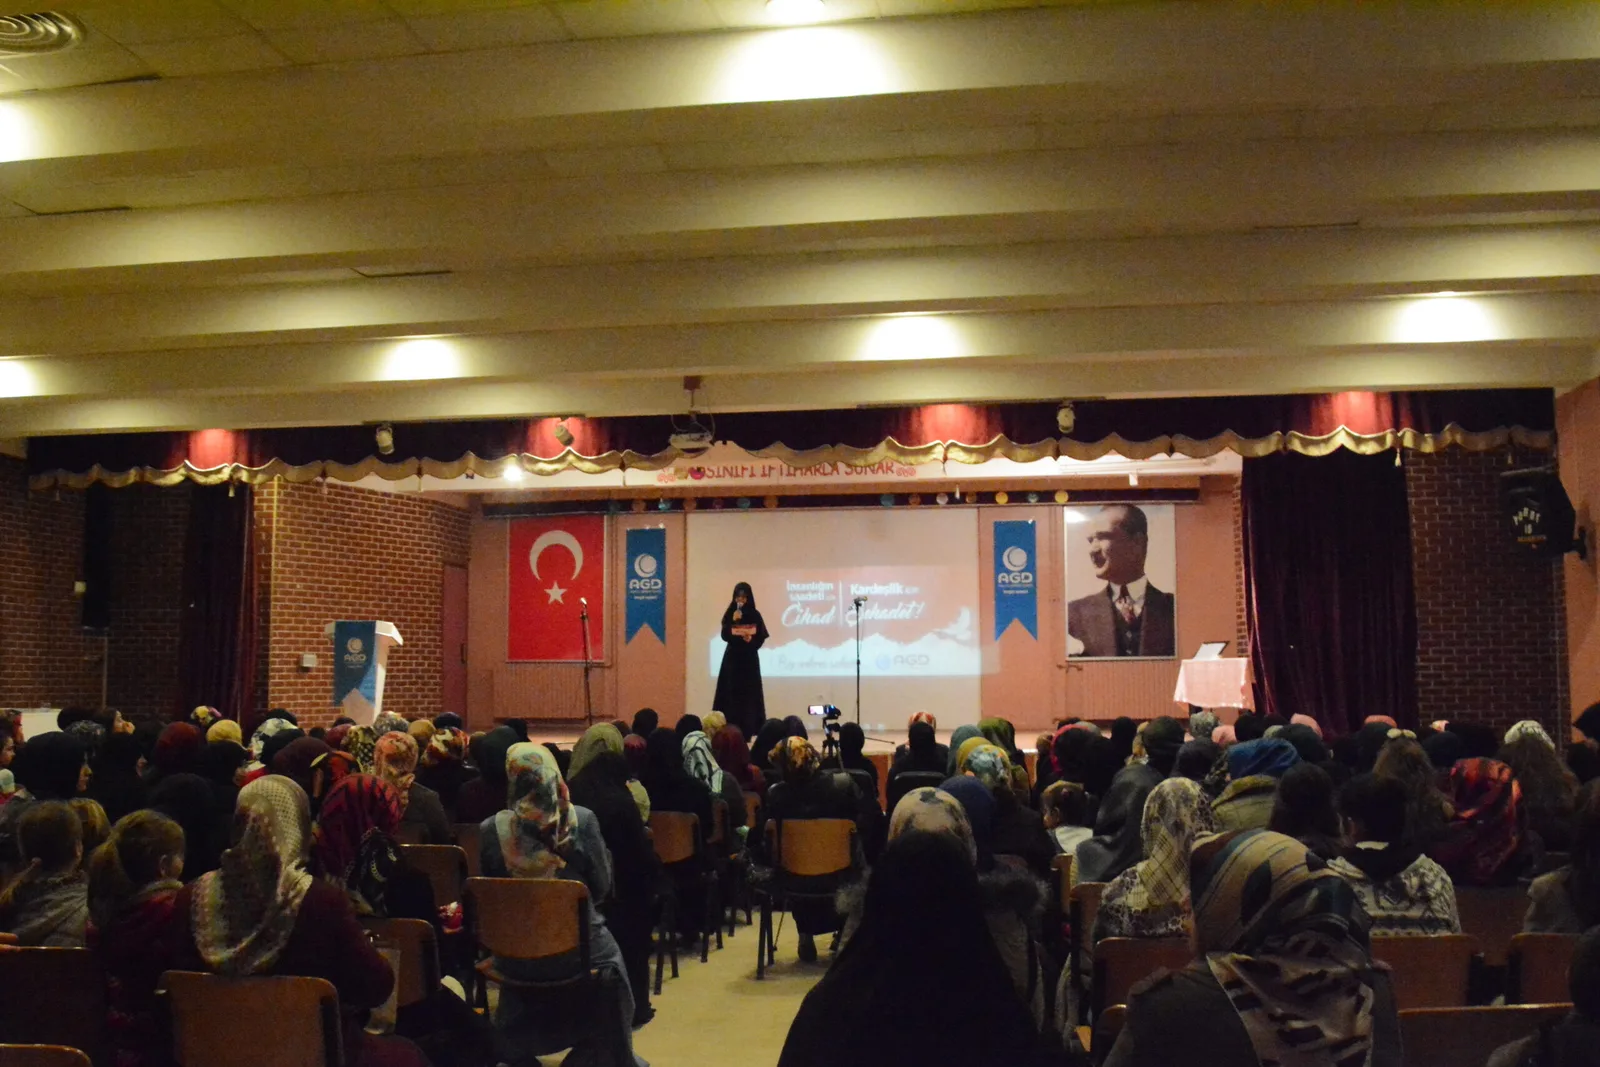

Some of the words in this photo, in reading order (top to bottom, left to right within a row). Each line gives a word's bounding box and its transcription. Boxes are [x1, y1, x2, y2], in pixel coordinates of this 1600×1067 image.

[998, 572, 1033, 583] AGD
[629, 579, 662, 589] AGD
[893, 654, 930, 666] AGD
